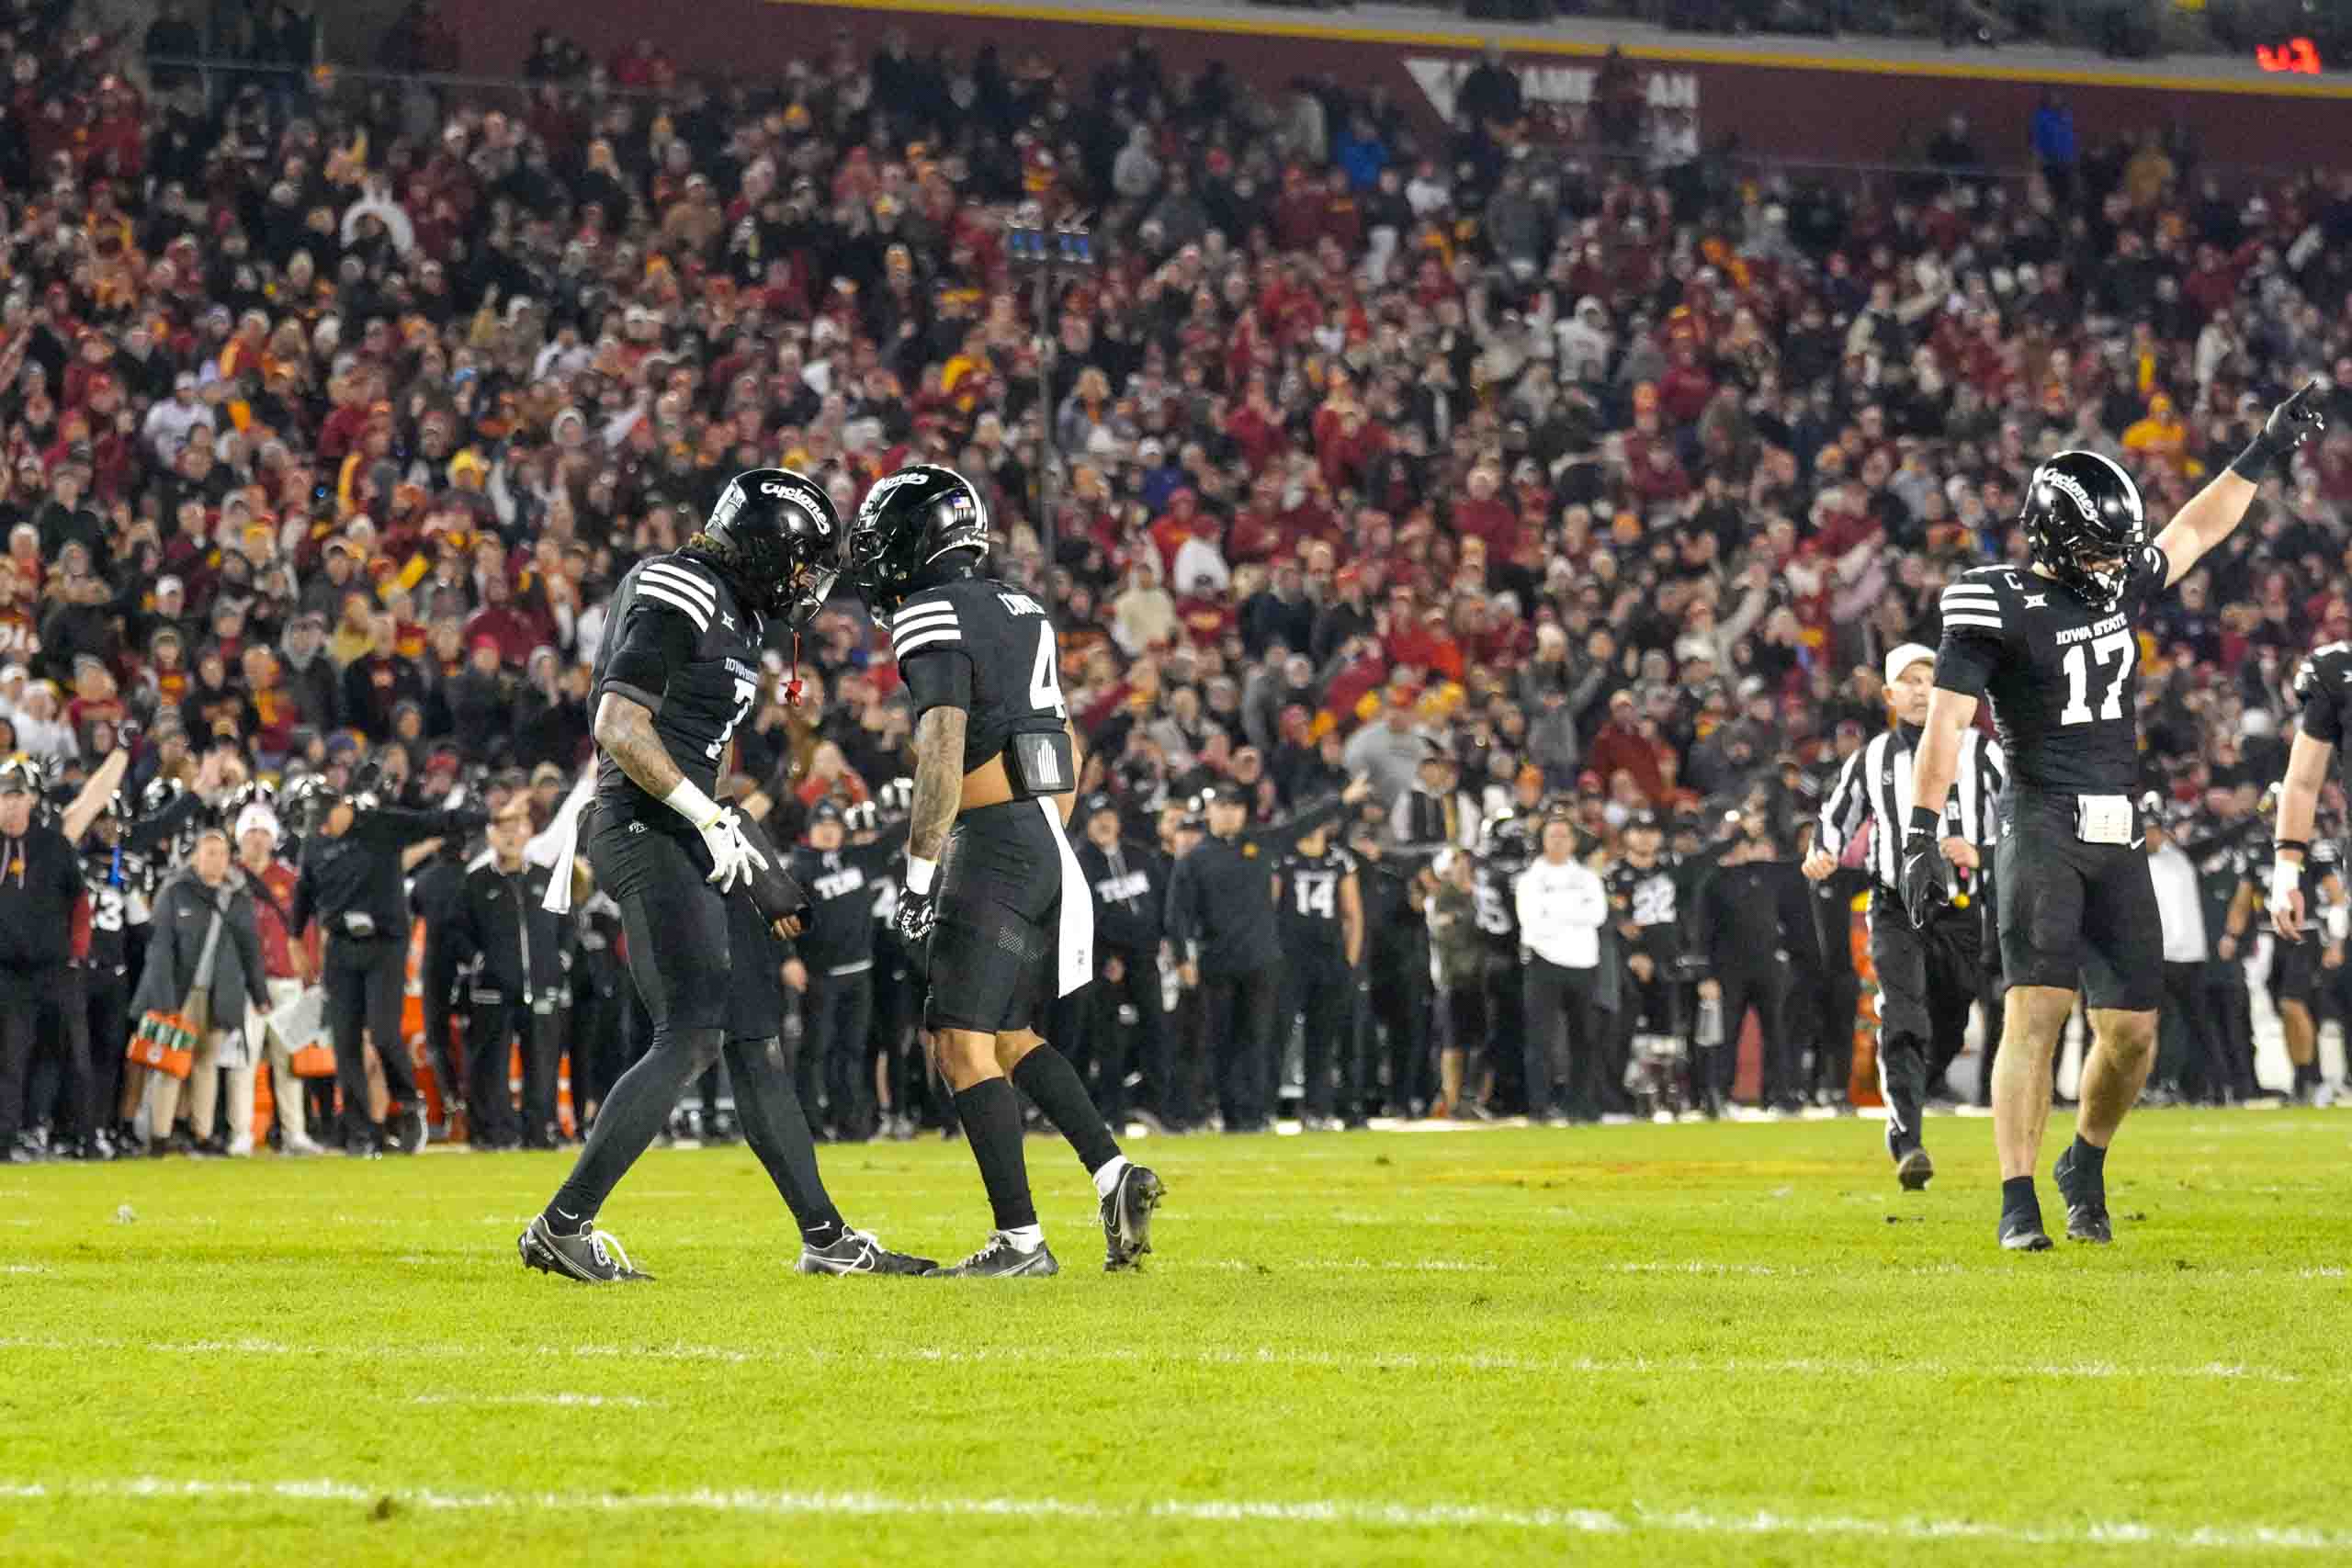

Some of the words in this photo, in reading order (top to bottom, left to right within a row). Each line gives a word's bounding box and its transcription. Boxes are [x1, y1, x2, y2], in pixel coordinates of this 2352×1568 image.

[760, 481, 831, 536] Cyclones
[2041, 467, 2099, 521] Cyclones
[2004, 572, 2023, 591] C
[2055, 626, 2093, 645] IOWA
[2093, 611, 2129, 636] STATE
[1029, 619, 1066, 719] 4
[2060, 627, 2135, 726] 17
[705, 677, 757, 761] 7
[1293, 869, 1335, 919] 14
